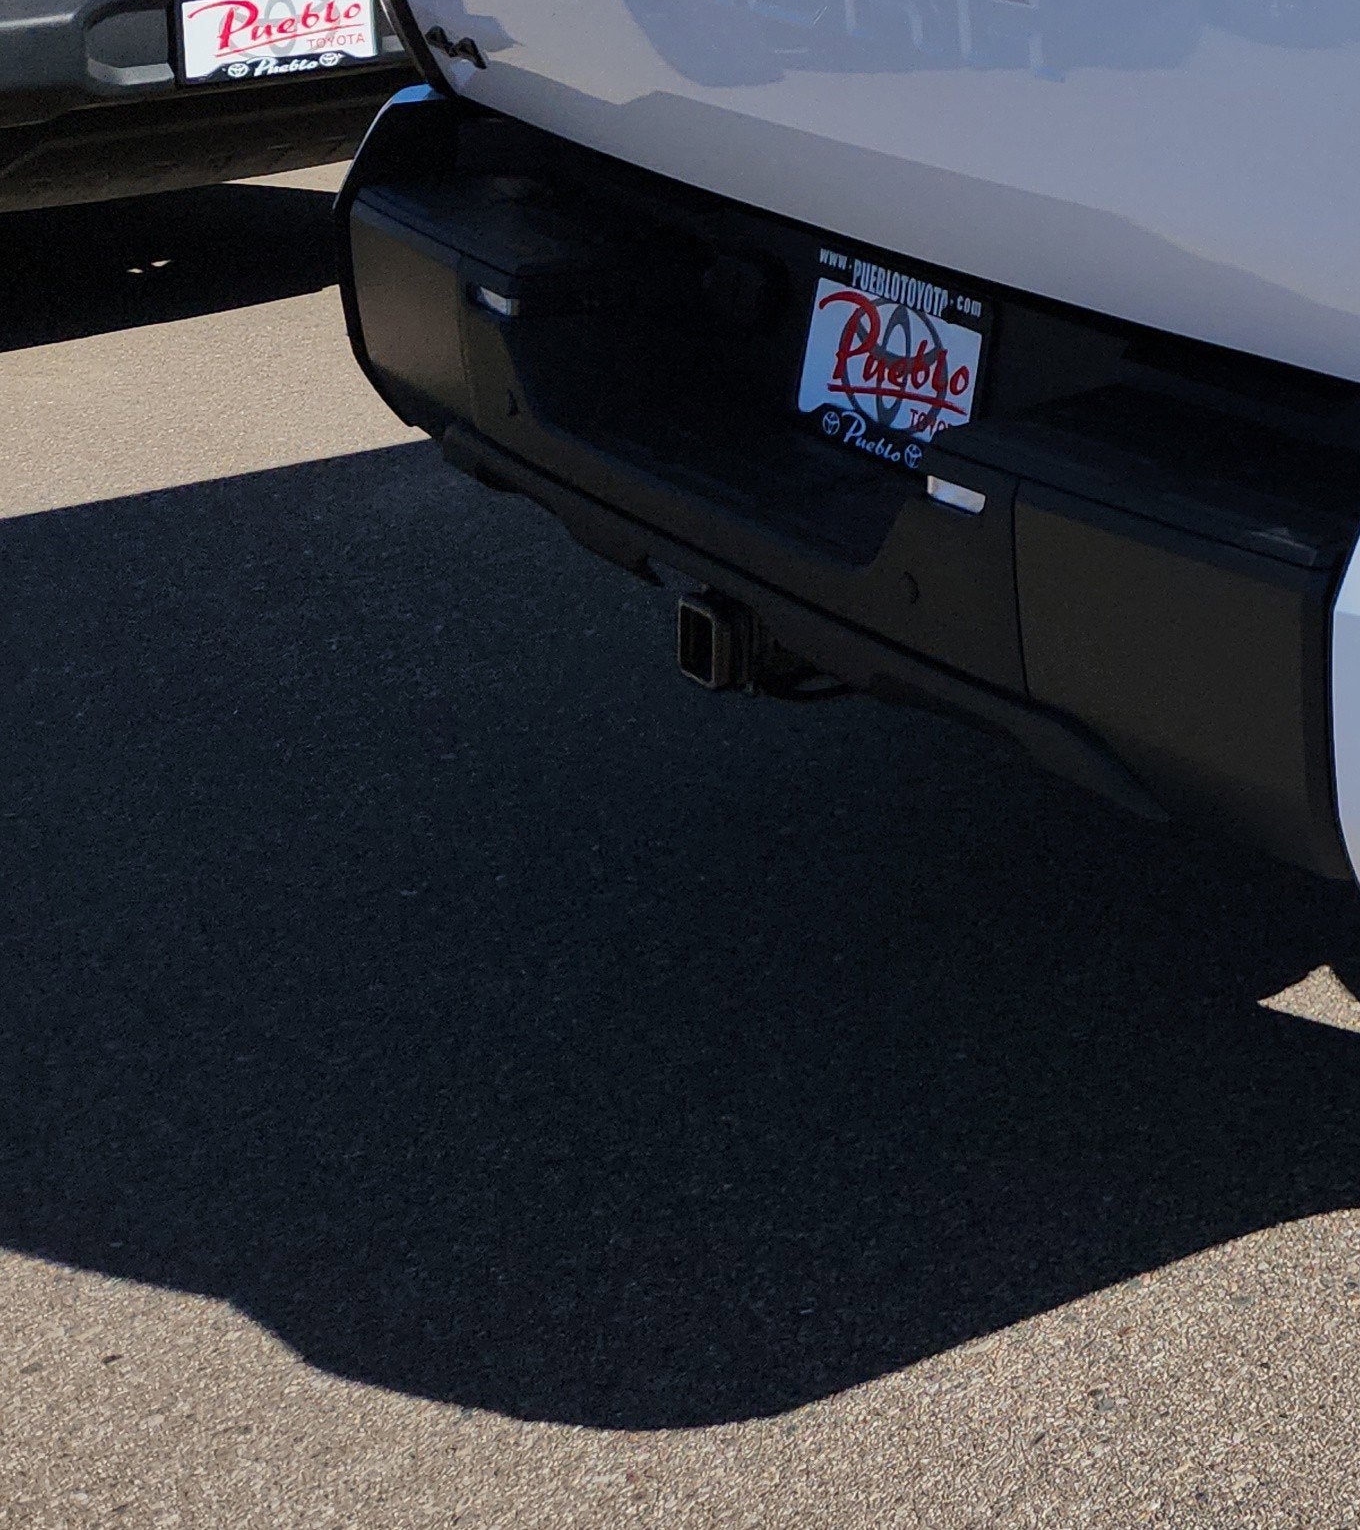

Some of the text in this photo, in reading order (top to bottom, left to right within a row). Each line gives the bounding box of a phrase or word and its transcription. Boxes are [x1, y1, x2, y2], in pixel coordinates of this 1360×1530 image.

[187, 0, 362, 51] Pueblo
[306, 33, 366, 51] TOYOTA
[247, 57, 319, 77] Pueblo
[818, 290, 971, 396] Pueblo
[841, 411, 901, 463] Pueblo
